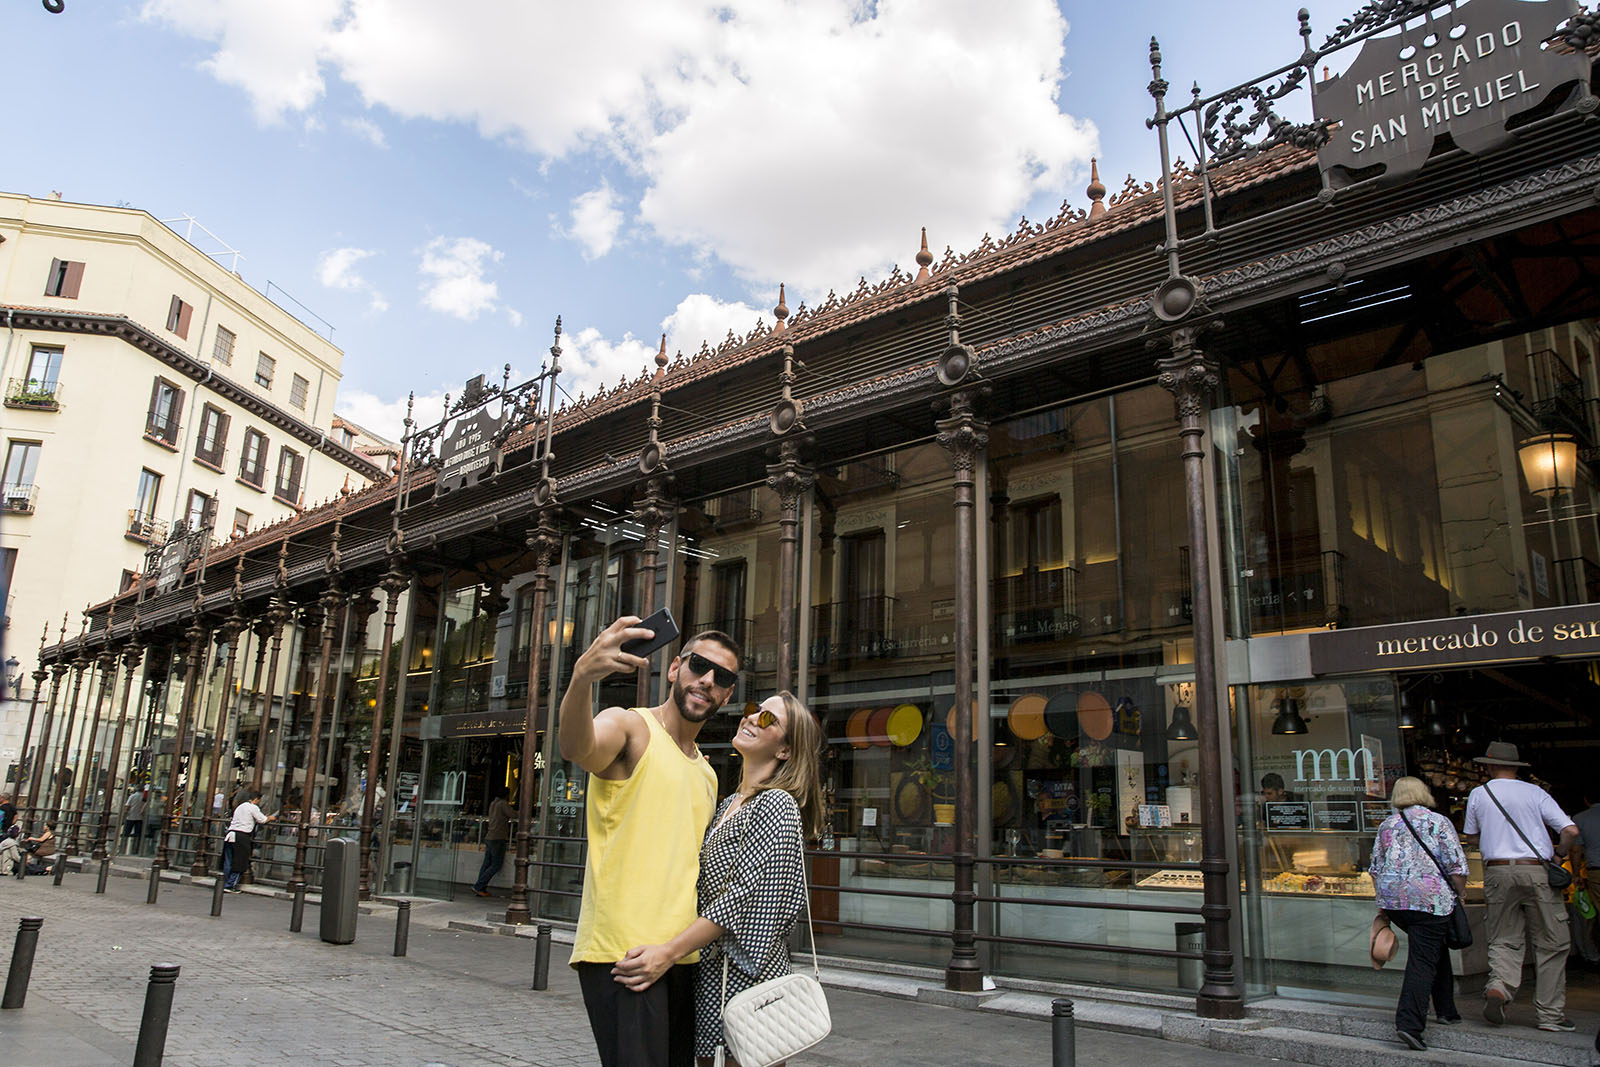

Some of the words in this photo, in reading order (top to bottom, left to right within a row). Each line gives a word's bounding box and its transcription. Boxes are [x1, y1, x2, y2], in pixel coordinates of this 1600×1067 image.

[1356, 21, 1522, 105] MERCADO
[1418, 71, 1462, 101] DE
[1350, 114, 1408, 153] SAN
[1036, 618, 1080, 634] Menaje
[1376, 623, 1499, 657] mercado
[1507, 619, 1545, 646] de
[1294, 784, 1327, 793] mercado
[1327, 784, 1337, 793] de
